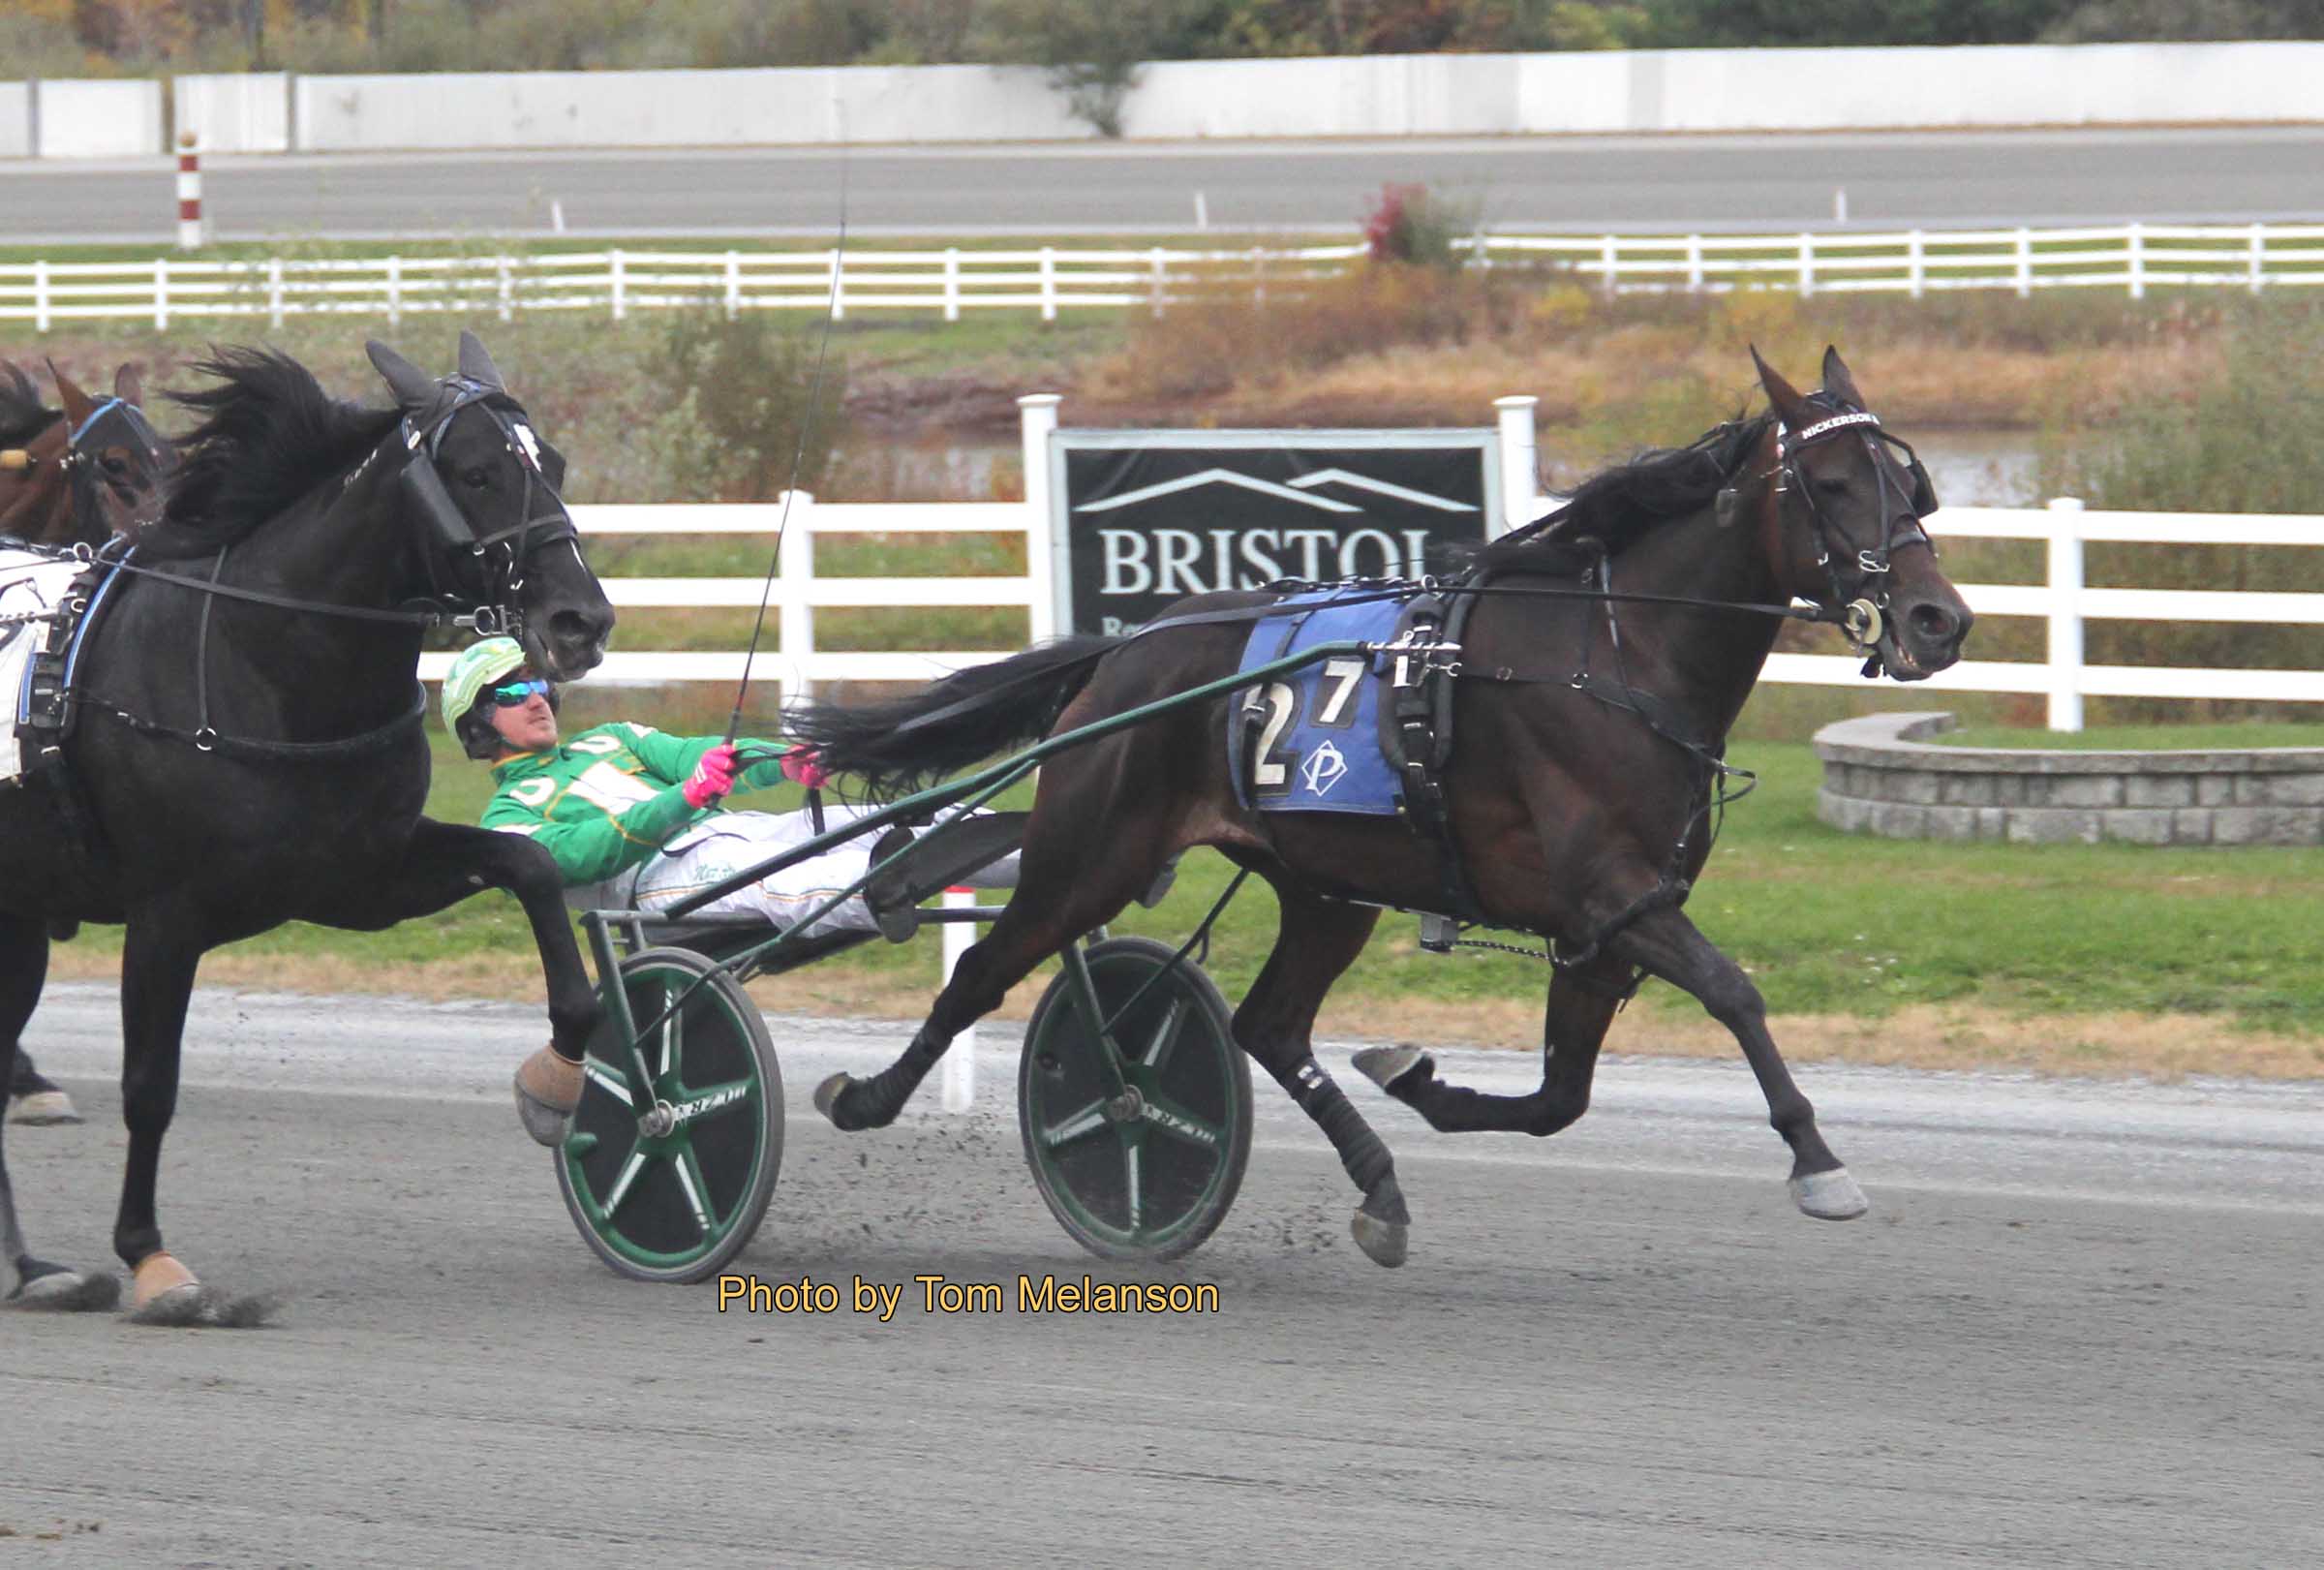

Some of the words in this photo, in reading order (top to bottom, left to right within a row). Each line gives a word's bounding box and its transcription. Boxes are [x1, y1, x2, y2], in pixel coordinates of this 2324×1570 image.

[1801, 413, 1873, 440] NICKERSON
[1319, 660, 1365, 723] 7
[1241, 682, 1295, 785] 2
